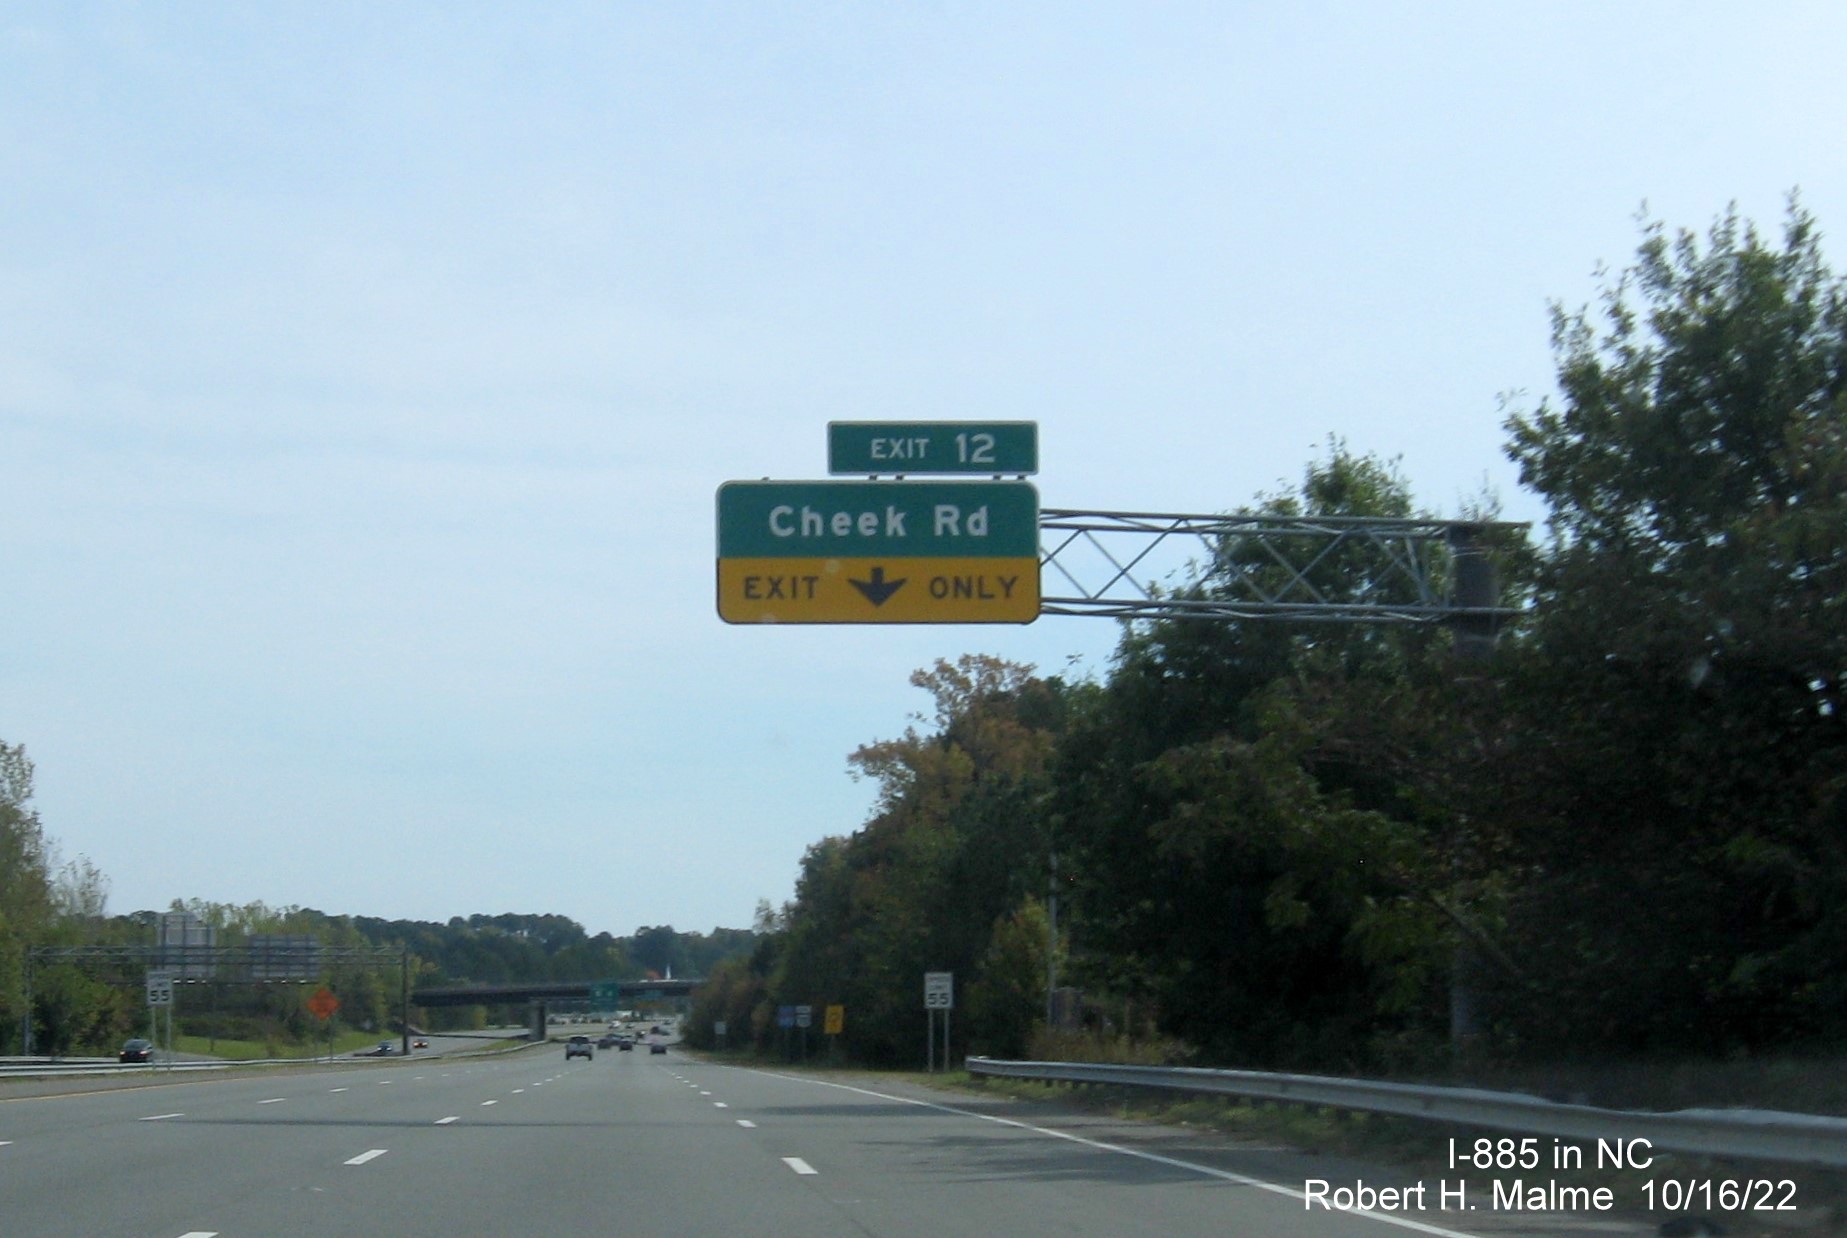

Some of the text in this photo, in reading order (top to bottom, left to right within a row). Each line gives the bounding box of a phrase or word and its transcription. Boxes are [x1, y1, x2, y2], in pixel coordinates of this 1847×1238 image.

[870, 433, 996, 464] EXIT 12
[768, 505, 989, 537] Cheek Rd
[744, 576, 1019, 600] EXIT ONLY
[150, 990, 169, 1002] 55
[927, 993, 949, 1006] 55
